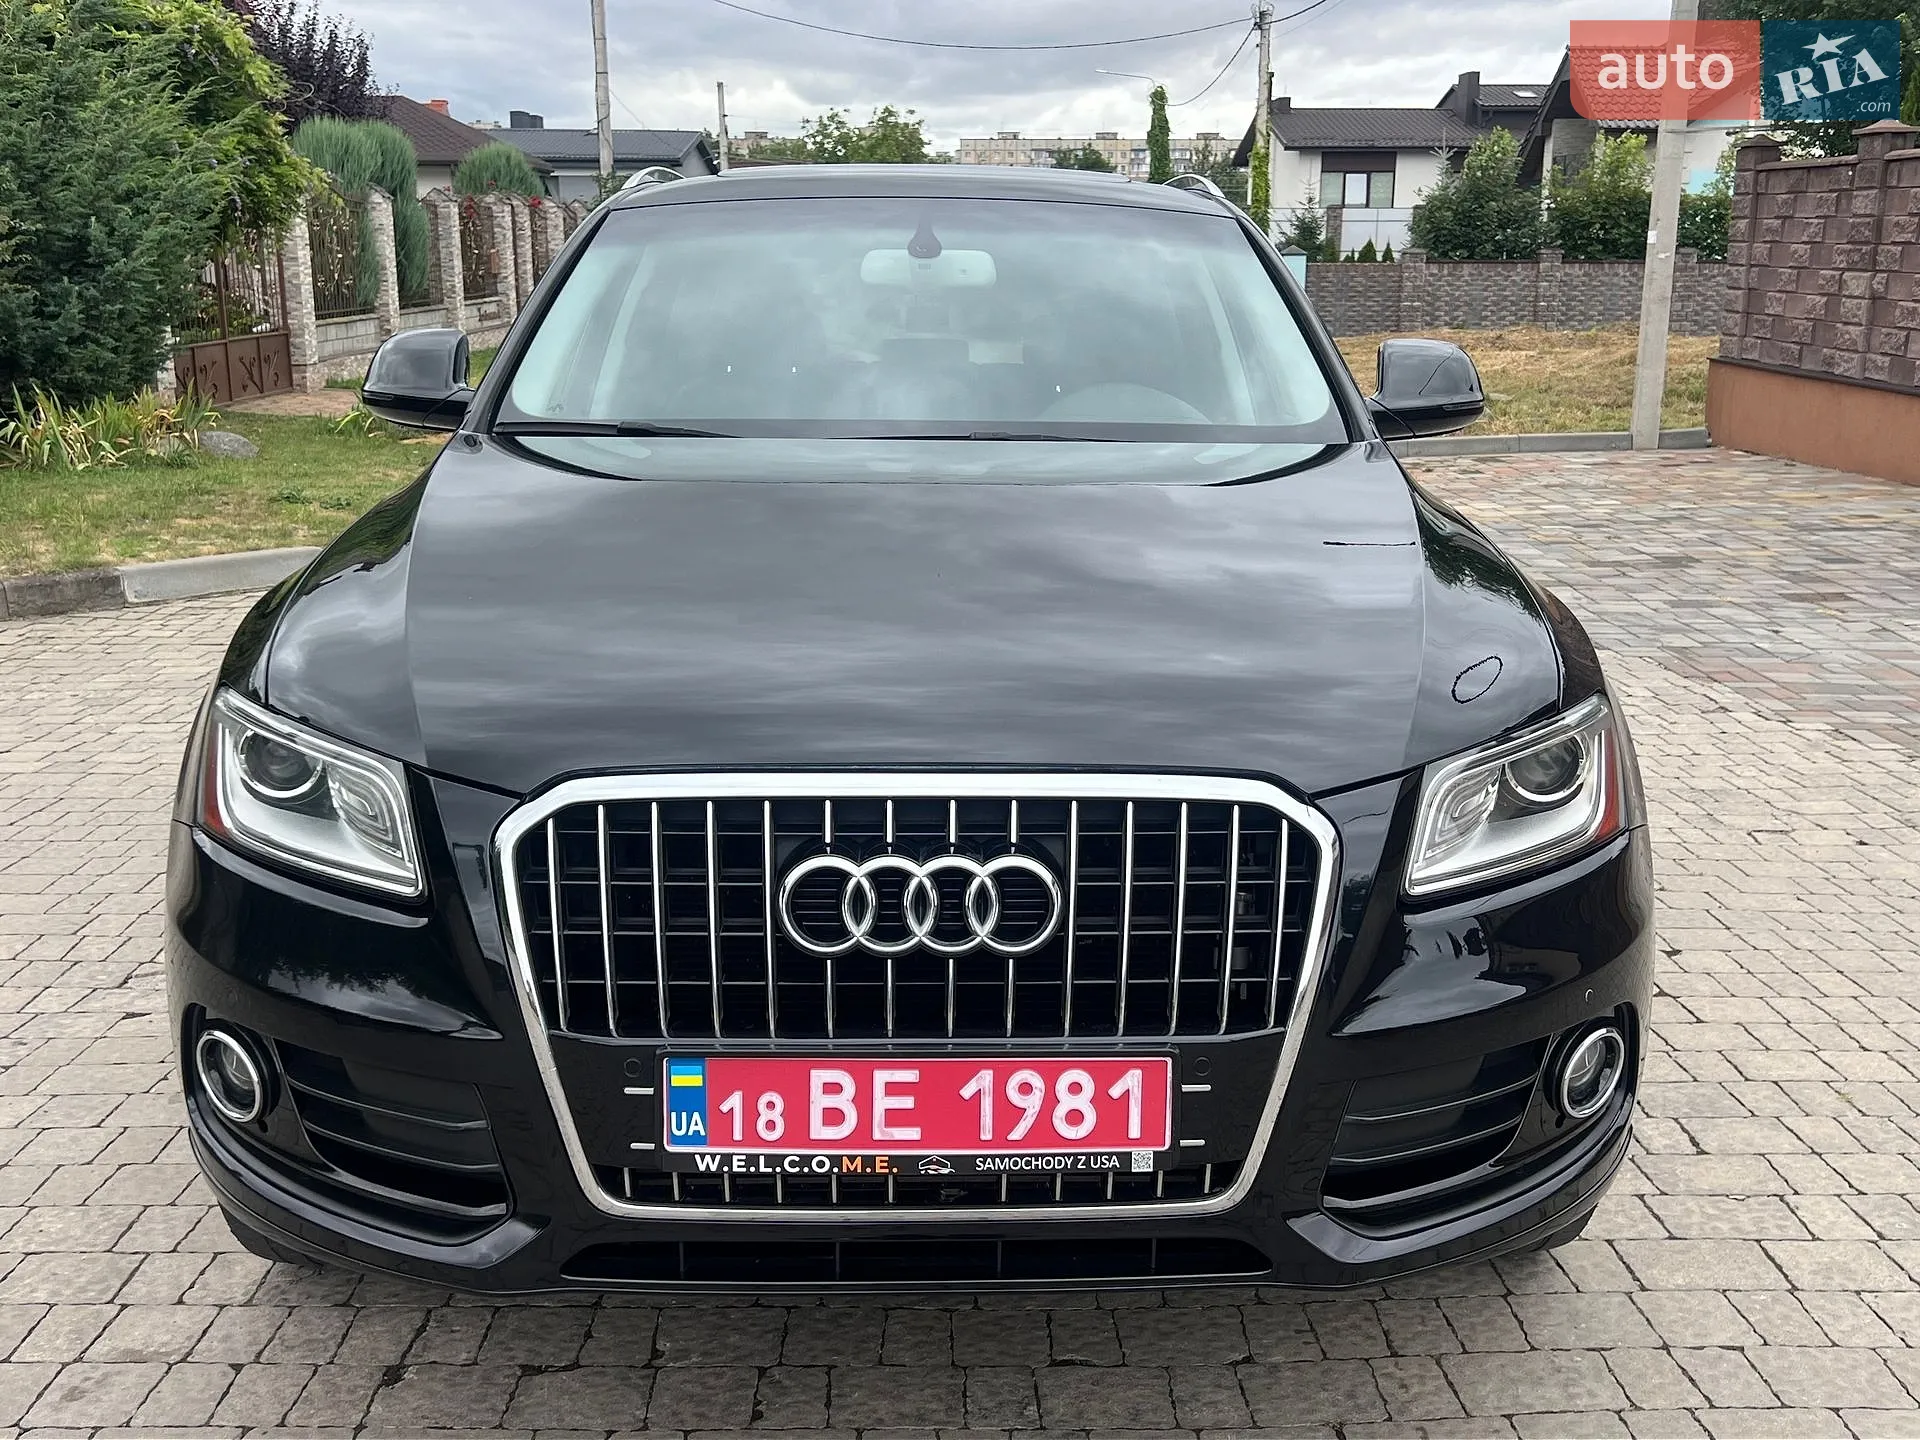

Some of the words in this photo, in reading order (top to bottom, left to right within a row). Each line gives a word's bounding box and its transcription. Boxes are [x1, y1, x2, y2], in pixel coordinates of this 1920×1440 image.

[718, 1091, 785, 1142] 18
[808, 1068, 922, 1141] BE
[958, 1068, 1144, 1141] 1981
[670, 1111, 706, 1137] UA
[694, 1153, 899, 1174] W.E.L.C.O.M.E.
[974, 1155, 1075, 1172] SAMOCHODY
[1077, 1155, 1087, 1169] Z
[1089, 1154, 1121, 1169] USA
